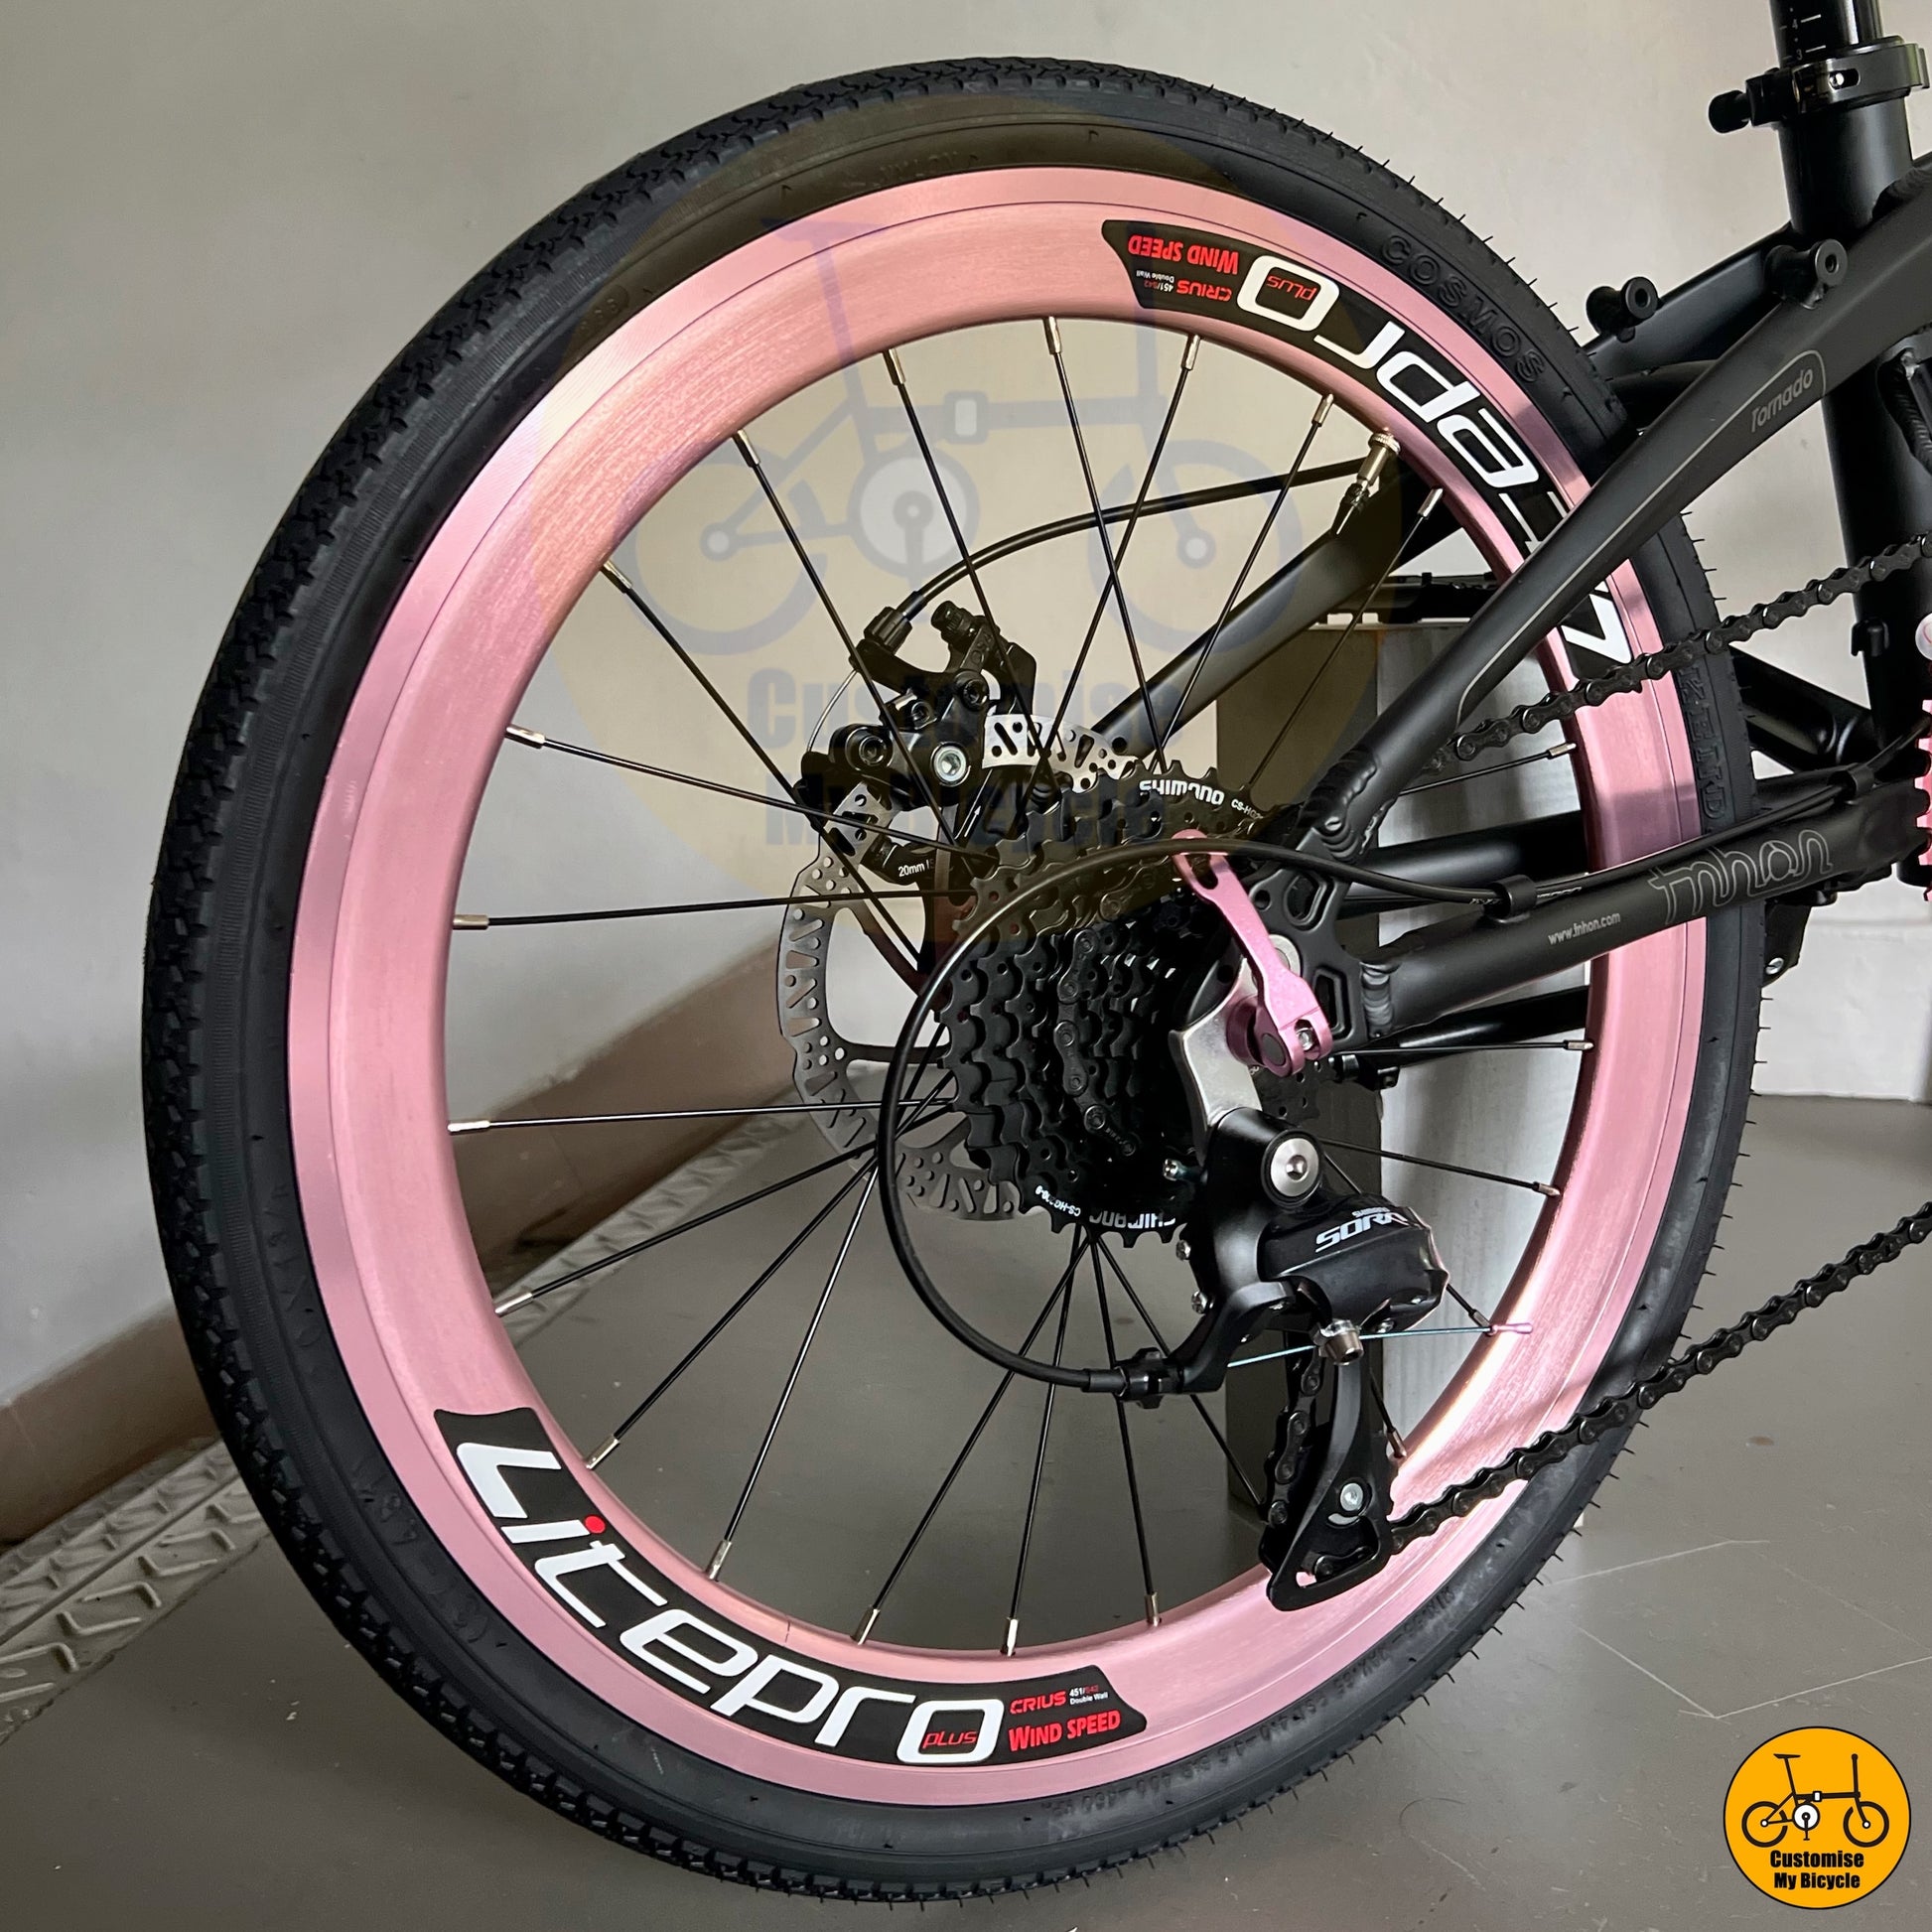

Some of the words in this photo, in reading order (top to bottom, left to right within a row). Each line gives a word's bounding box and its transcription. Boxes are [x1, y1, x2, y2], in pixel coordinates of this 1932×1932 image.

[1128, 234, 1184, 263] SPEED
[1186, 244, 1239, 275] WIND
[1152, 271, 1174, 284] Double
[1176, 279, 1232, 302] CRIUS
[1382, 234, 1547, 383] COSMOS
[1751, 368, 1814, 433] Tornado
[1139, 779, 1225, 806] SHIMANO
[897, 862, 926, 878] 20mm
[1548, 912, 1621, 945] www.fnhon.com
[1315, 1212, 1410, 1252] SORA
[1010, 1691, 1067, 1715] CRIUS
[1069, 1695, 1093, 1706] Double
[1009, 1722, 1062, 1751] WIND
[1066, 1710, 1121, 1739] SPEED
